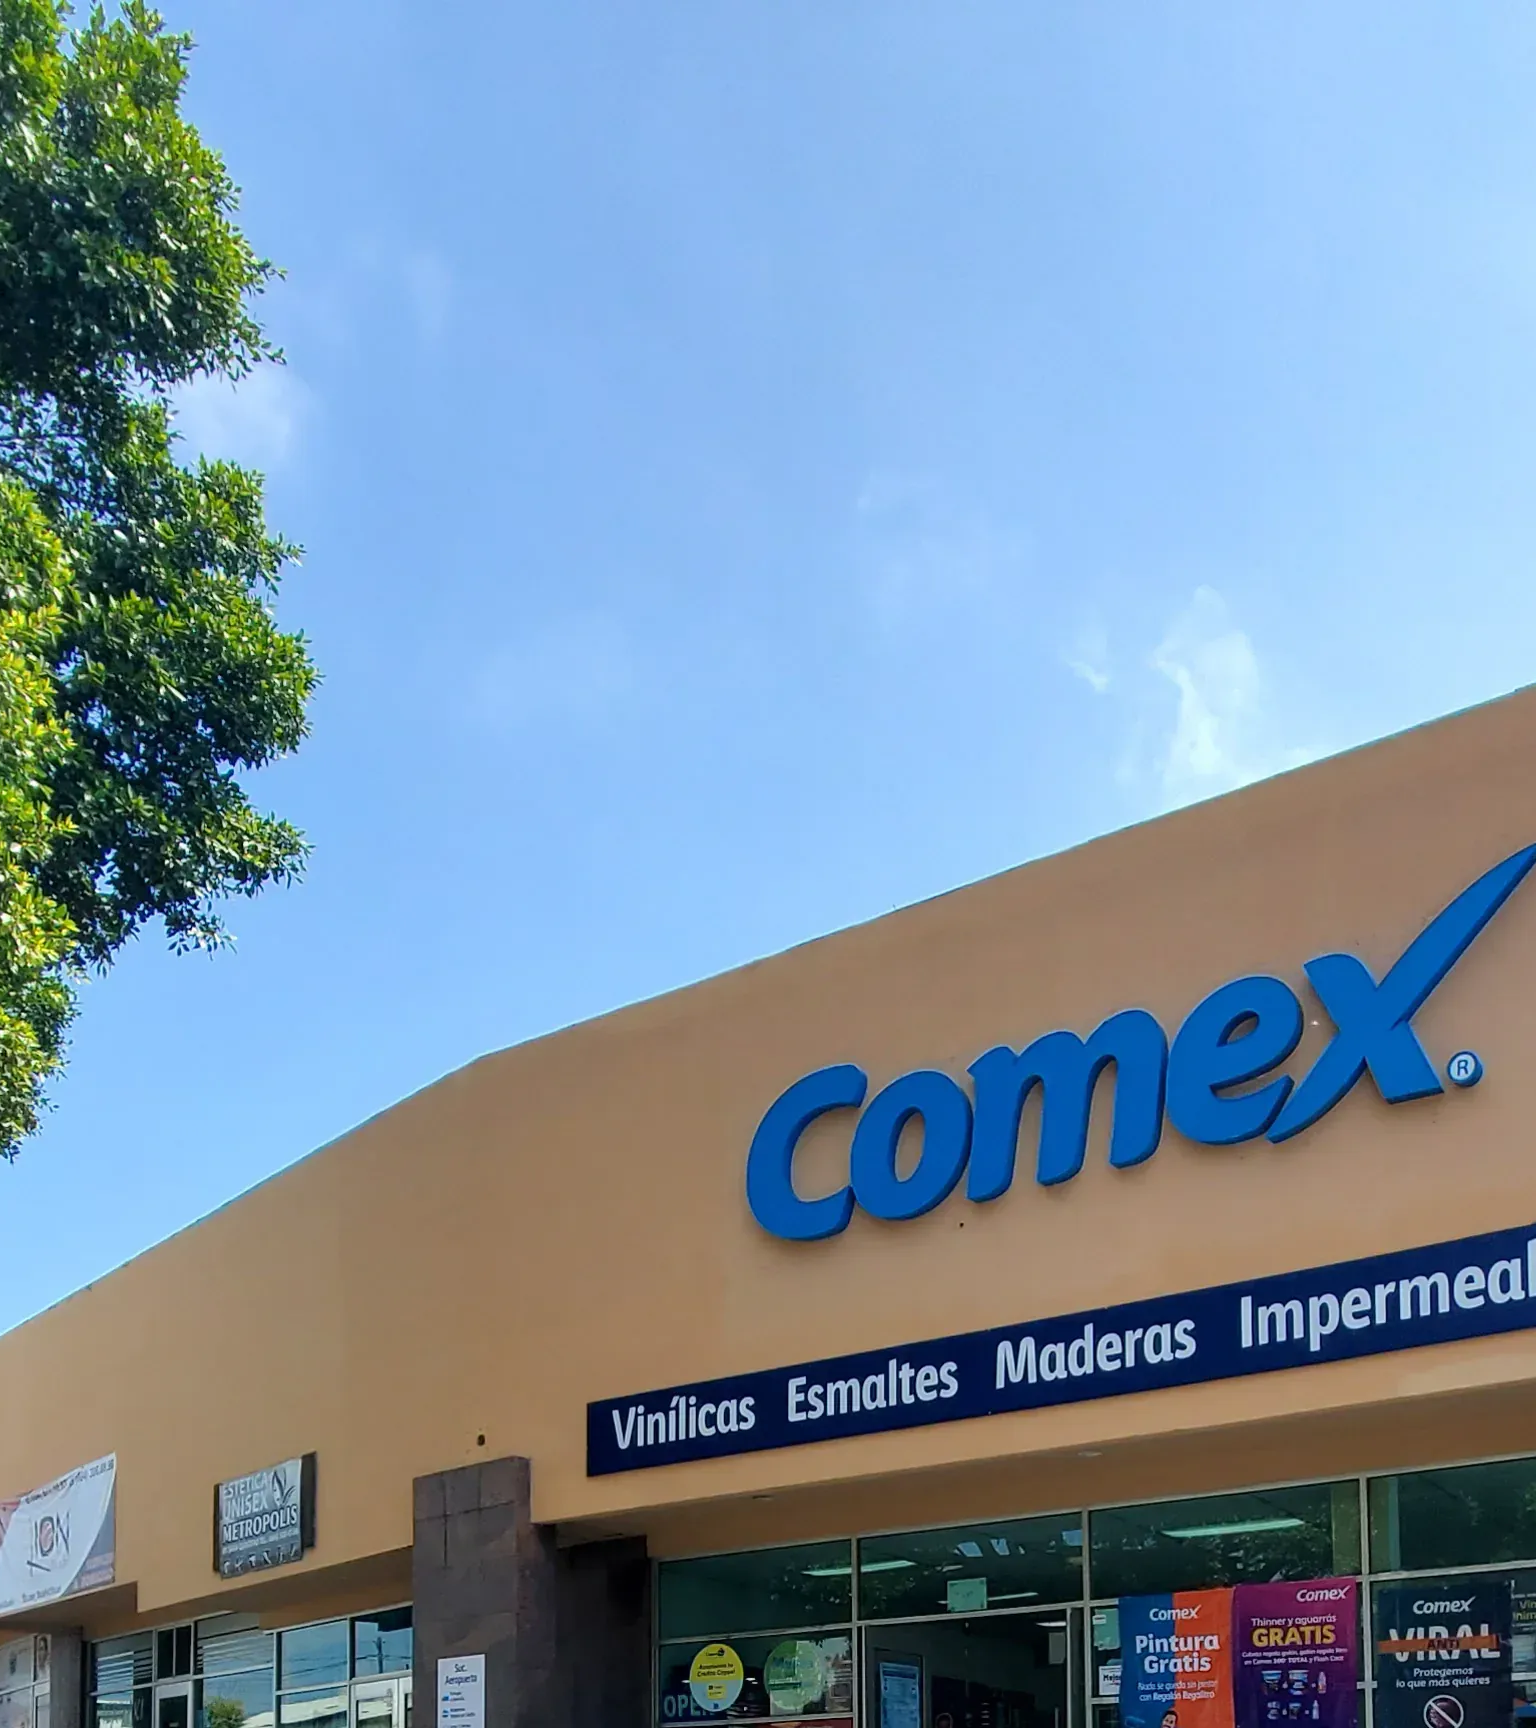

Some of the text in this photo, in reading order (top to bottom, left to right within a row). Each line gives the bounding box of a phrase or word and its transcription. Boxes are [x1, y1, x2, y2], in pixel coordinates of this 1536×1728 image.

[612, 1395, 756, 1450] Vinílicas
[787, 1358, 959, 1423] Esmaltes
[995, 1316, 1196, 1390] Maderas
[223, 1491, 269, 1520] UNISEX
[223, 1504, 298, 1543] METROPOLIS
[1296, 1585, 1351, 1602] Comex
[1150, 1604, 1202, 1621] Comex
[1413, 1596, 1476, 1614] Comex
[1251, 1617, 1285, 1627] Thinner
[1287, 1618, 1294, 1627] y
[1135, 1633, 1220, 1654] Pintura
[1252, 1624, 1336, 1648] GRATIS
[1389, 1624, 1501, 1662] VIRAL
[1427, 1640, 1460, 1650] ANTI
[1144, 1652, 1211, 1673] Gratis
[1413, 1667, 1474, 1678] Protegemos
[1396, 1676, 1491, 1690] lo que más quieres
[664, 1695, 713, 1718] OPE
